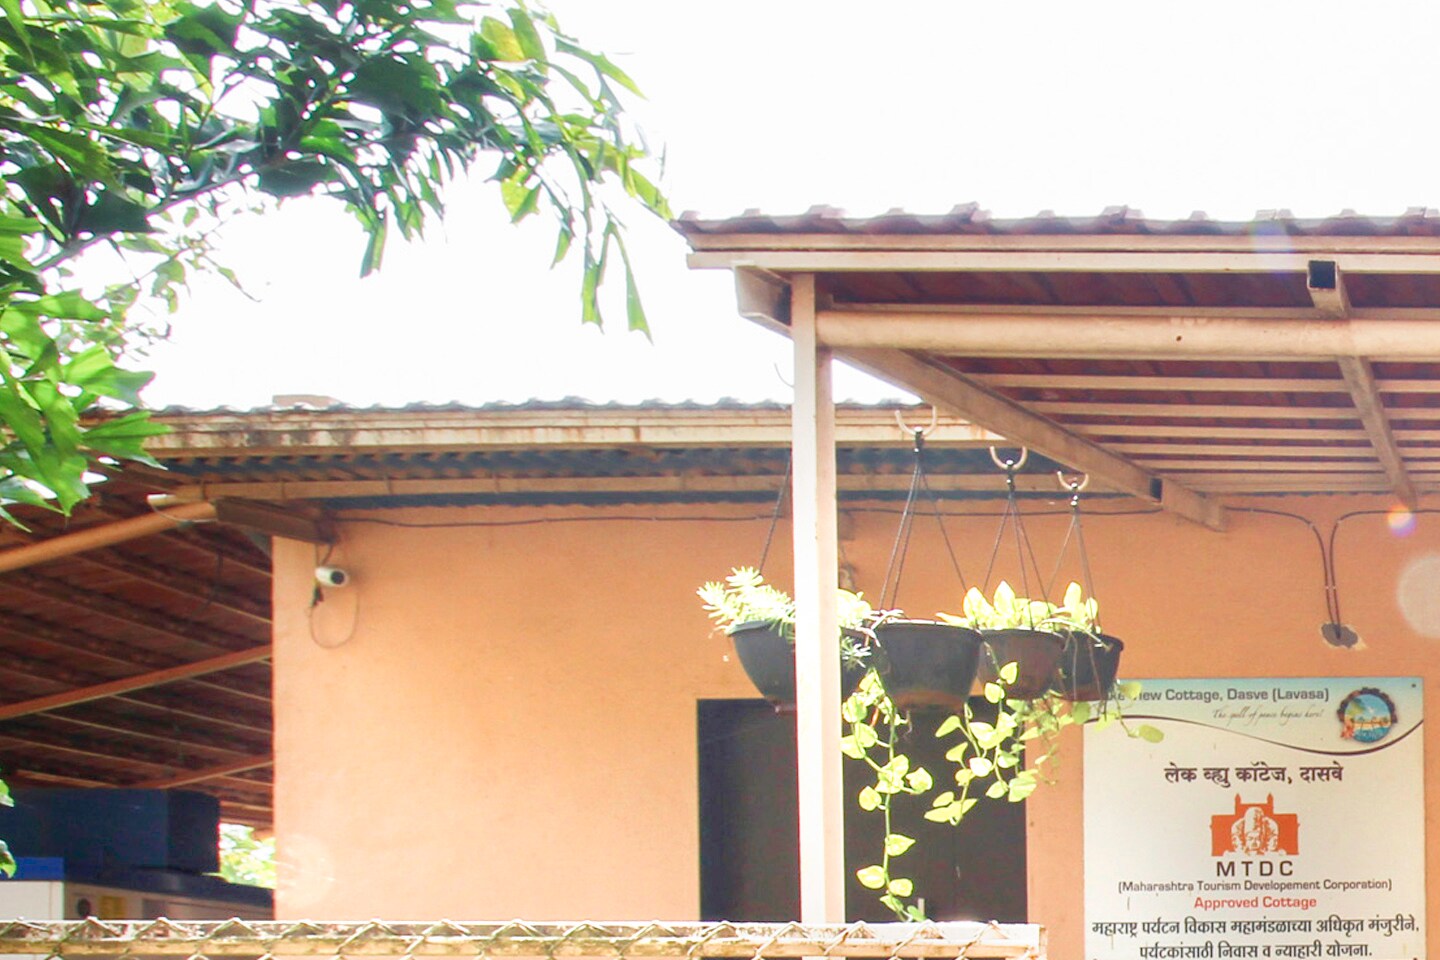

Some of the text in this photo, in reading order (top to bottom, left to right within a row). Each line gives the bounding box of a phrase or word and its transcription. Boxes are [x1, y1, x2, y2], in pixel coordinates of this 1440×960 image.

[1165, 688, 1223, 704] Cottage,
[1227, 688, 1268, 700] Dasve
[1272, 688, 1329, 702] (Lavasa)
[1164, 762, 1197, 783] लेक
[1235, 761, 1292, 784] कॉटेज,
[1300, 761, 1344, 783] दासवे
[1118, 878, 1392, 894] (Maharashtra Tourism Developement Corporation)
[1194, 895, 1317, 911] Approved Cottage
[1092, 921, 1138, 938] महाराष्ट्र
[1142, 917, 1180, 935] पर्यटन
[1183, 916, 1226, 934] विकास
[1316, 914, 1364, 937] अधिकृत
[1139, 939, 1372, 959] पर्यटकांसाठी निवास व न्याहारी योजना.
